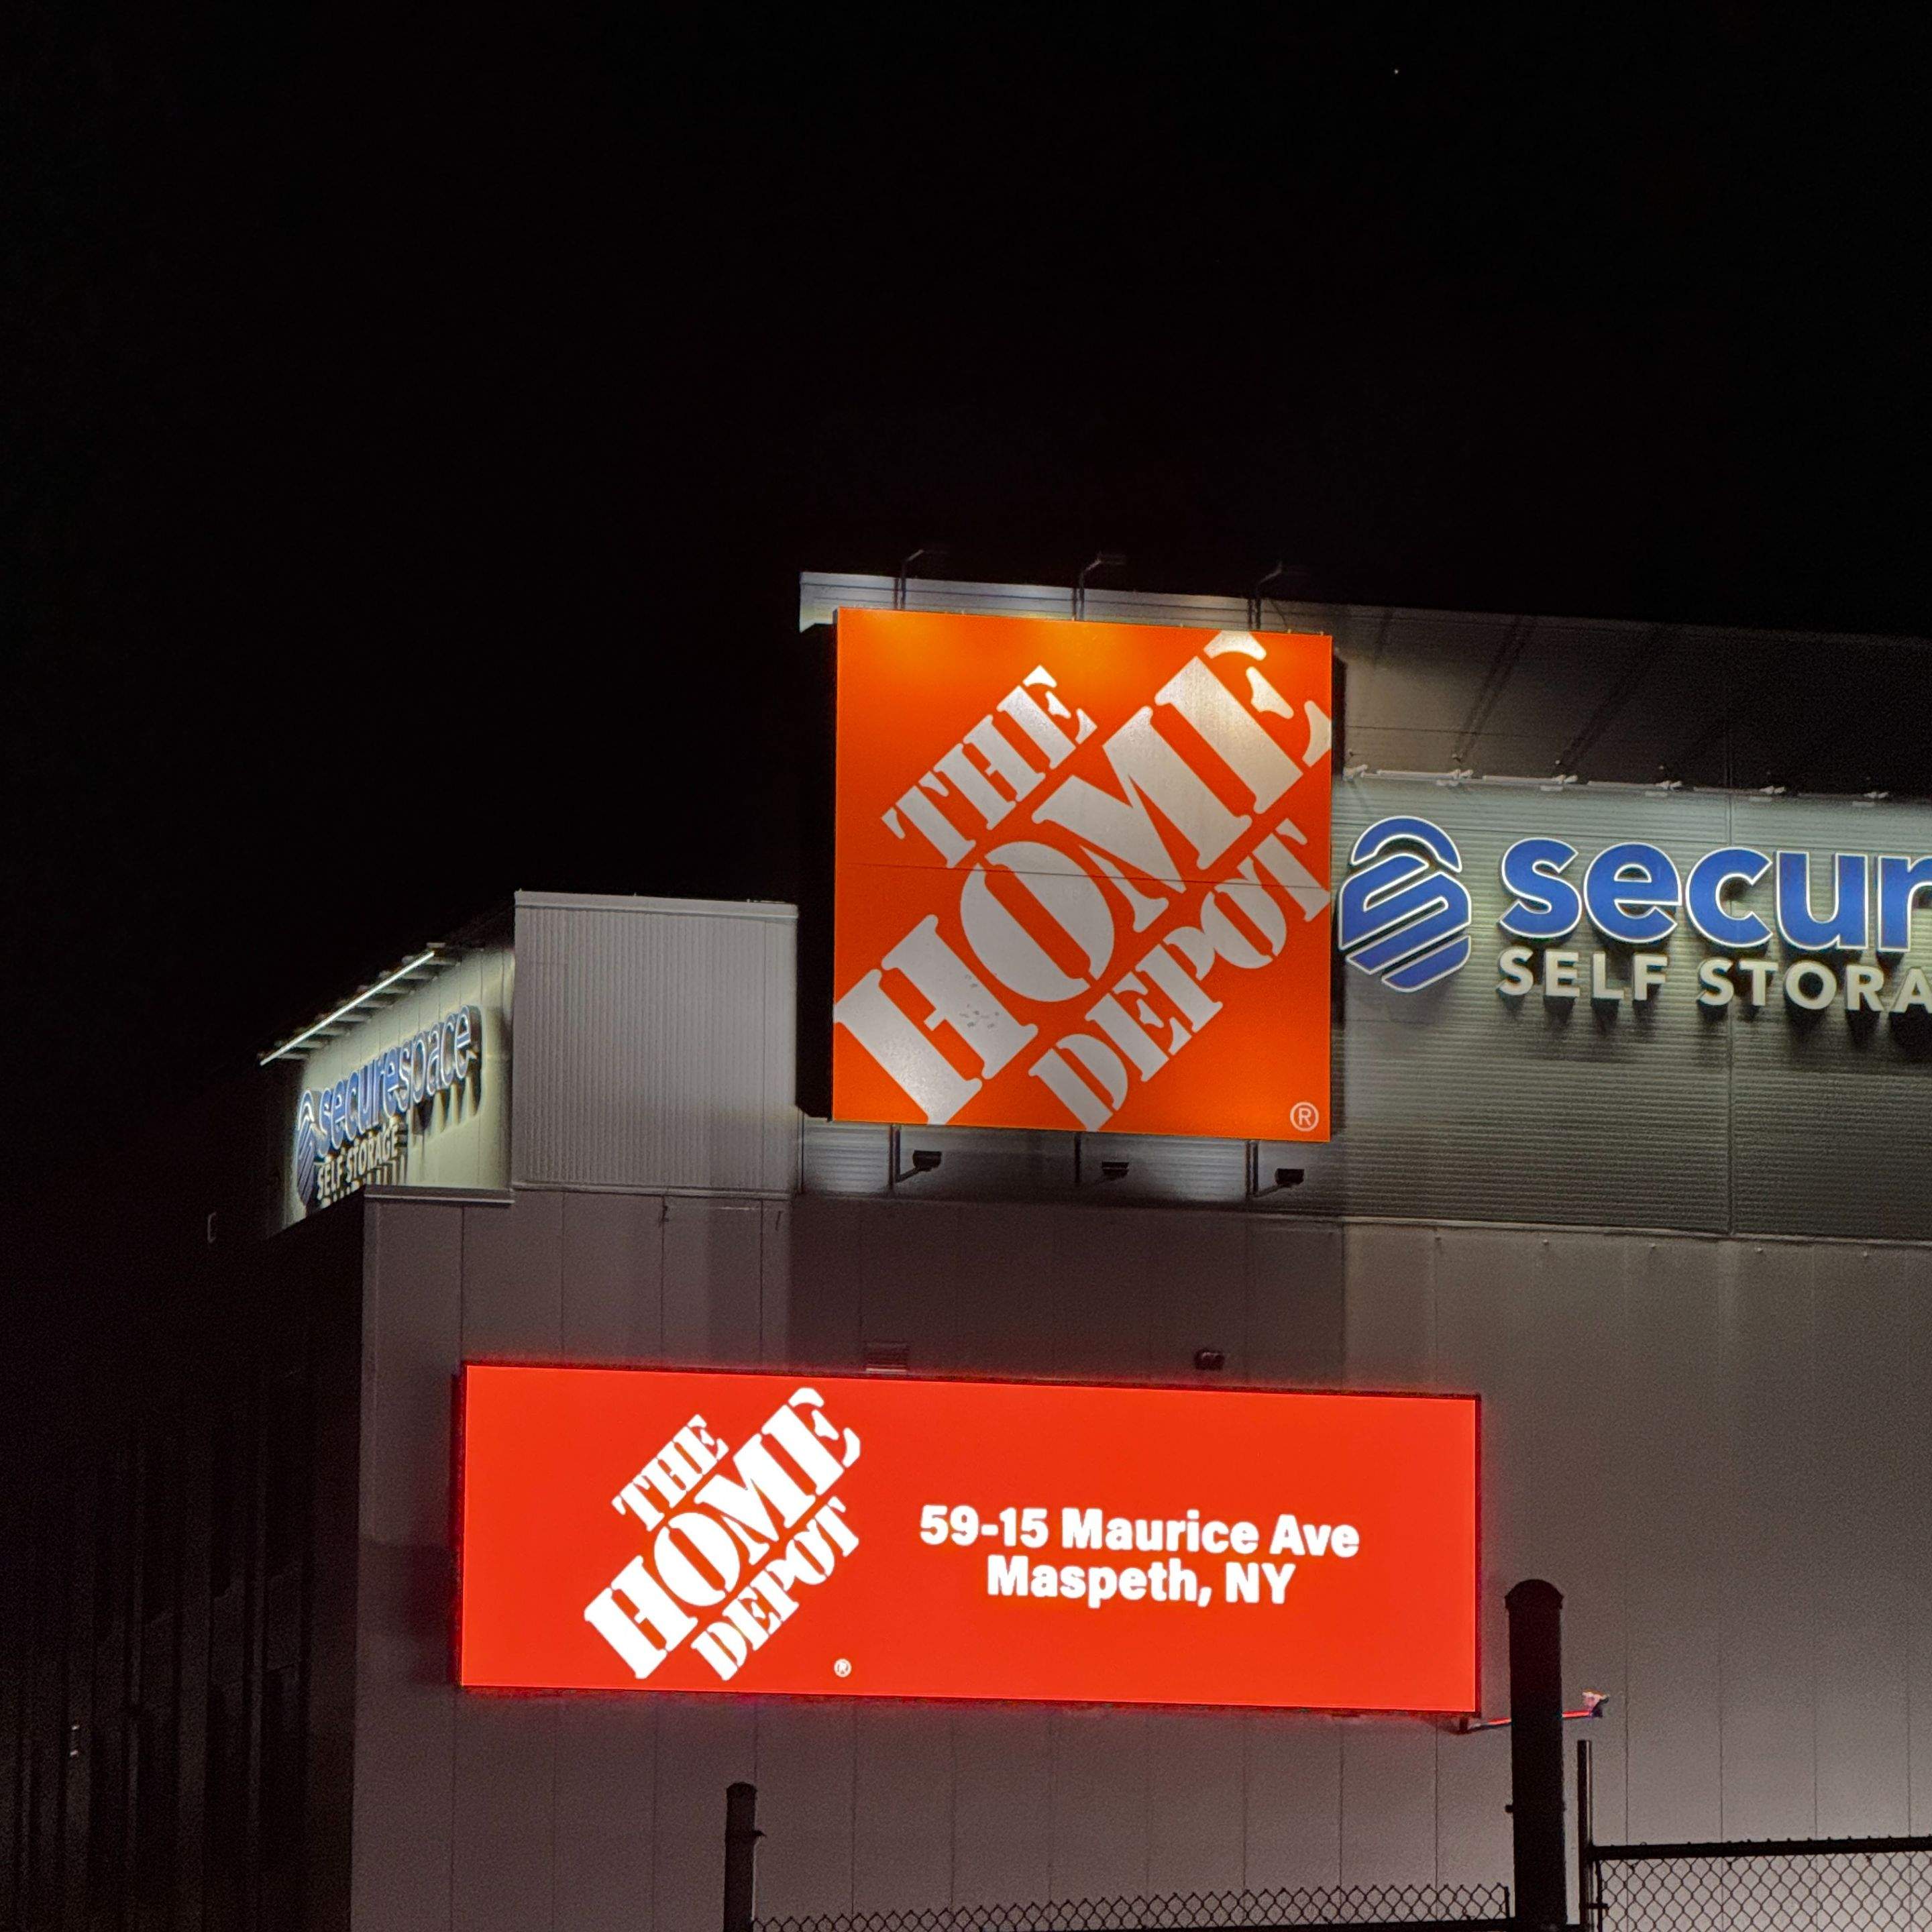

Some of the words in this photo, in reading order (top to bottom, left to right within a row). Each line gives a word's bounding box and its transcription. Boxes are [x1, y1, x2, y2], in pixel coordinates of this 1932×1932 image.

[881, 665, 1097, 869] THE
[833, 631, 1331, 1126] HOME
[1498, 837, 1932, 953] secur
[1028, 818, 1330, 1132] DEPOT
[1497, 947, 1669, 1002] SELF
[1696, 958, 1932, 1014] STORA
[319, 1005, 478, 1158] securespace
[317, 1155, 343, 1201] SELF
[346, 1124, 400, 1183] STORAGE
[584, 1387, 861, 1679] HOME
[611, 1414, 729, 1532] THE
[920, 1505, 1049, 1548] 59-15
[1061, 1507, 1259, 1554] Maurice
[1269, 1514, 1360, 1558] Ave
[690, 1496, 860, 1680] DEPOT
[987, 1554, 1212, 1609] Maspeth,
[1225, 1562, 1295, 1605] NY
